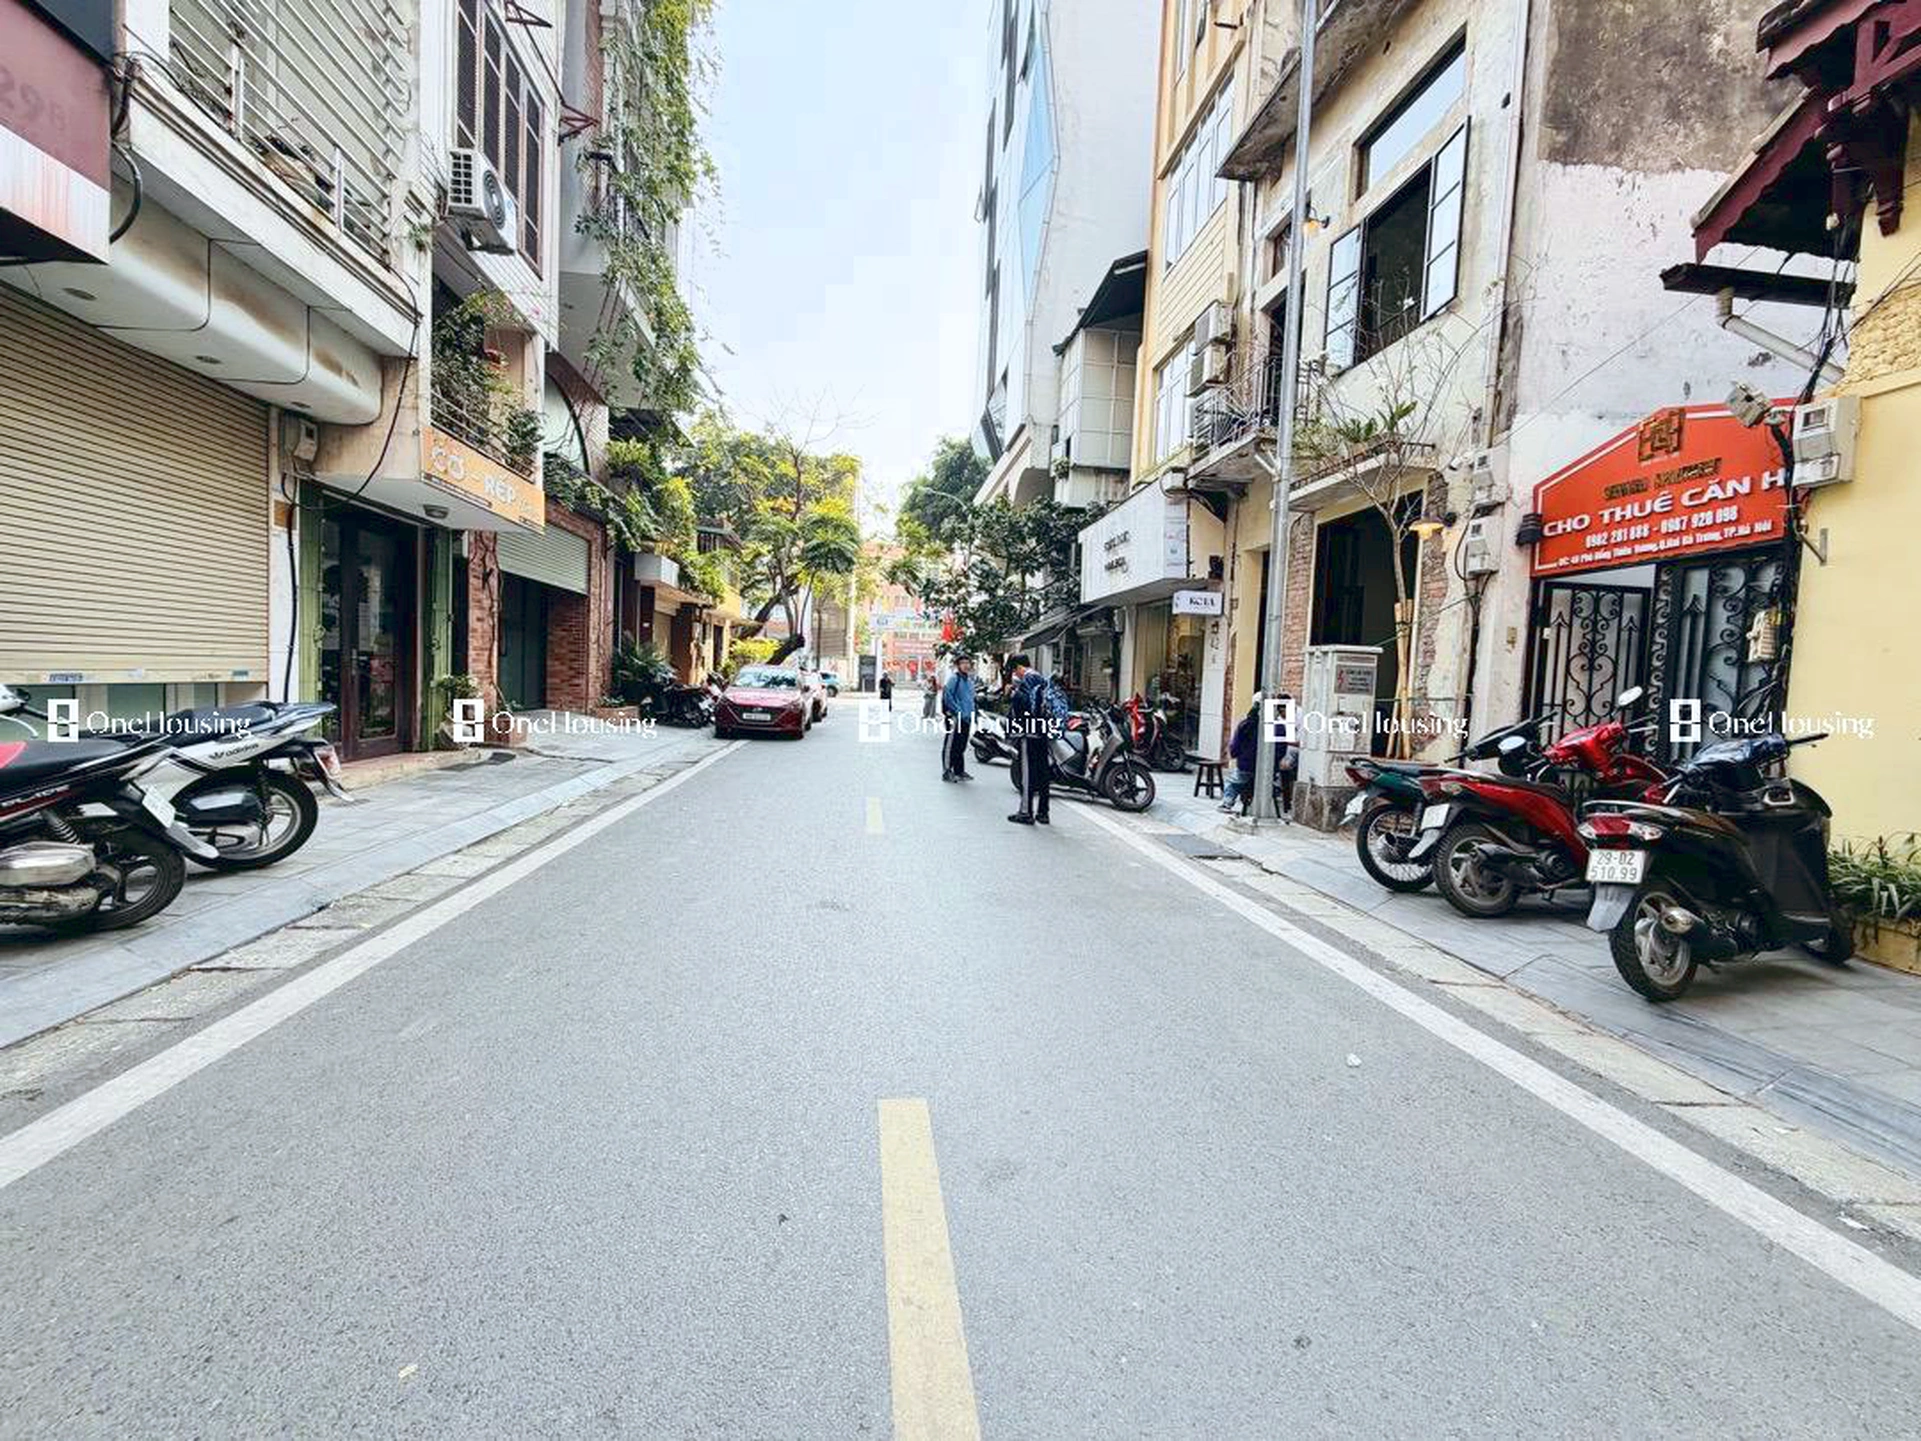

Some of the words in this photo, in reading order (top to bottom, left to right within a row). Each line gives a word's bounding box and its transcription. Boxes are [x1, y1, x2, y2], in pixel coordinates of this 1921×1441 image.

[1543, 514, 1591, 537] CHO
[1599, 490, 1673, 524] THUÊ
[1761, 467, 1785, 491] H
